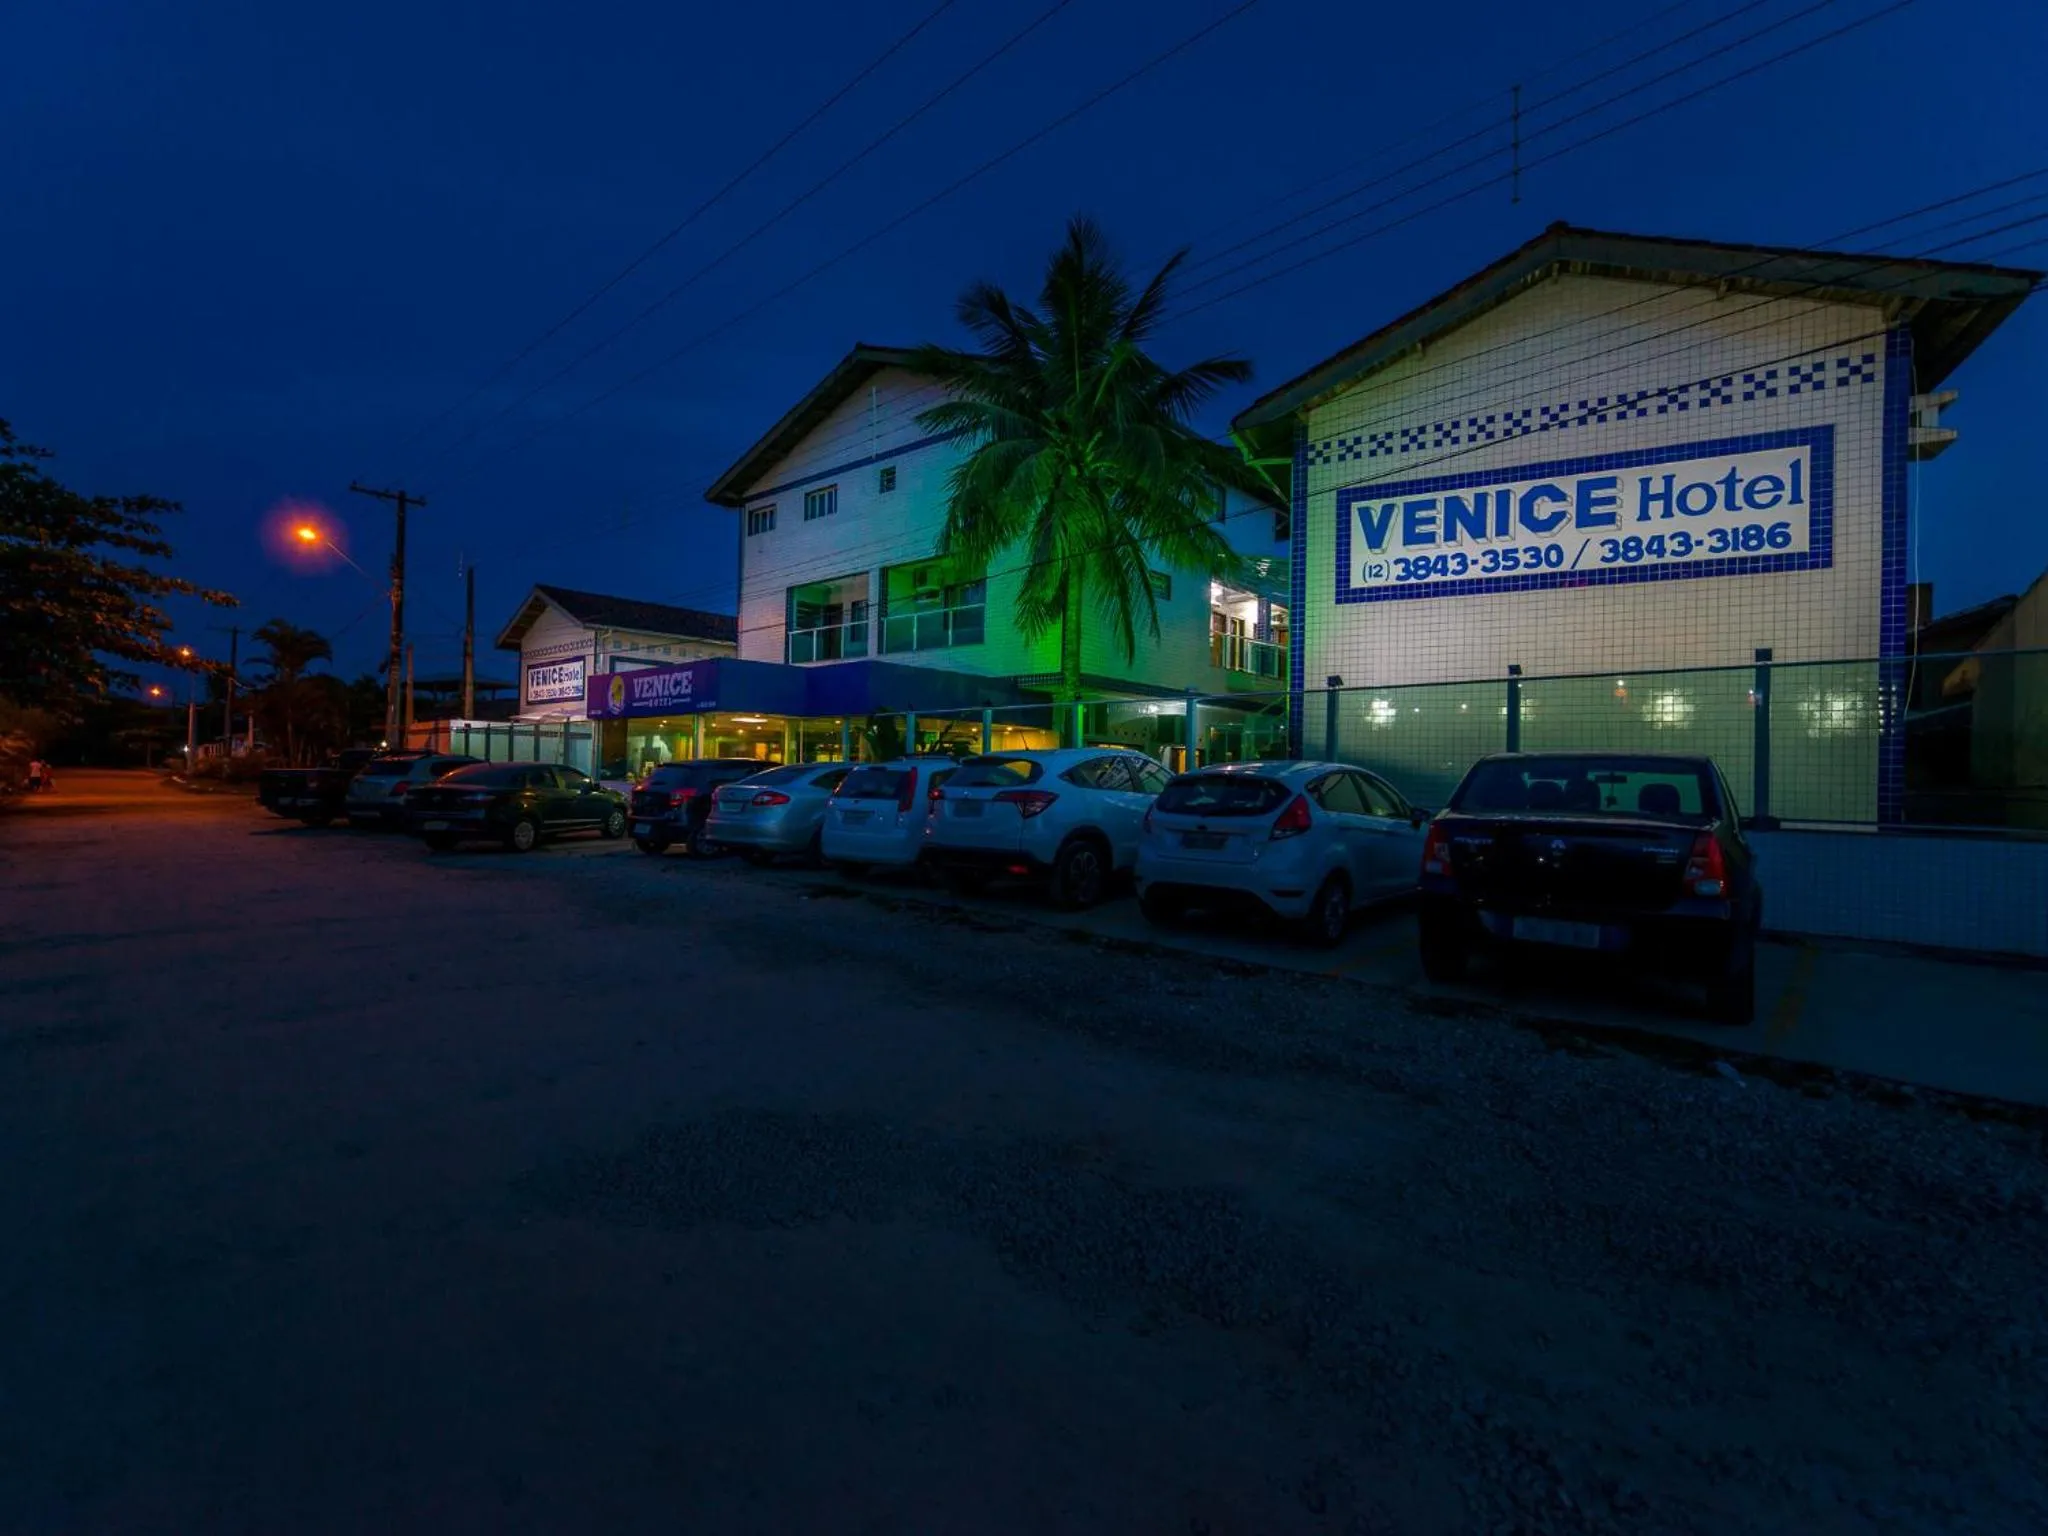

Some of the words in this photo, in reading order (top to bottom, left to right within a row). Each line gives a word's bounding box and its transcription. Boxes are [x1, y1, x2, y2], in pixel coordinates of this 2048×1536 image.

[1357, 476, 1622, 553] VENICE
[1637, 458, 1803, 521] Hotel
[1363, 558, 1390, 583] (12)
[1393, 543, 1564, 582] 3843-3530
[1571, 538, 1590, 570] /
[1600, 521, 1792, 563] 3843-3186
[530, 667, 563, 687] VENICE
[633, 670, 693, 698] VENICE
